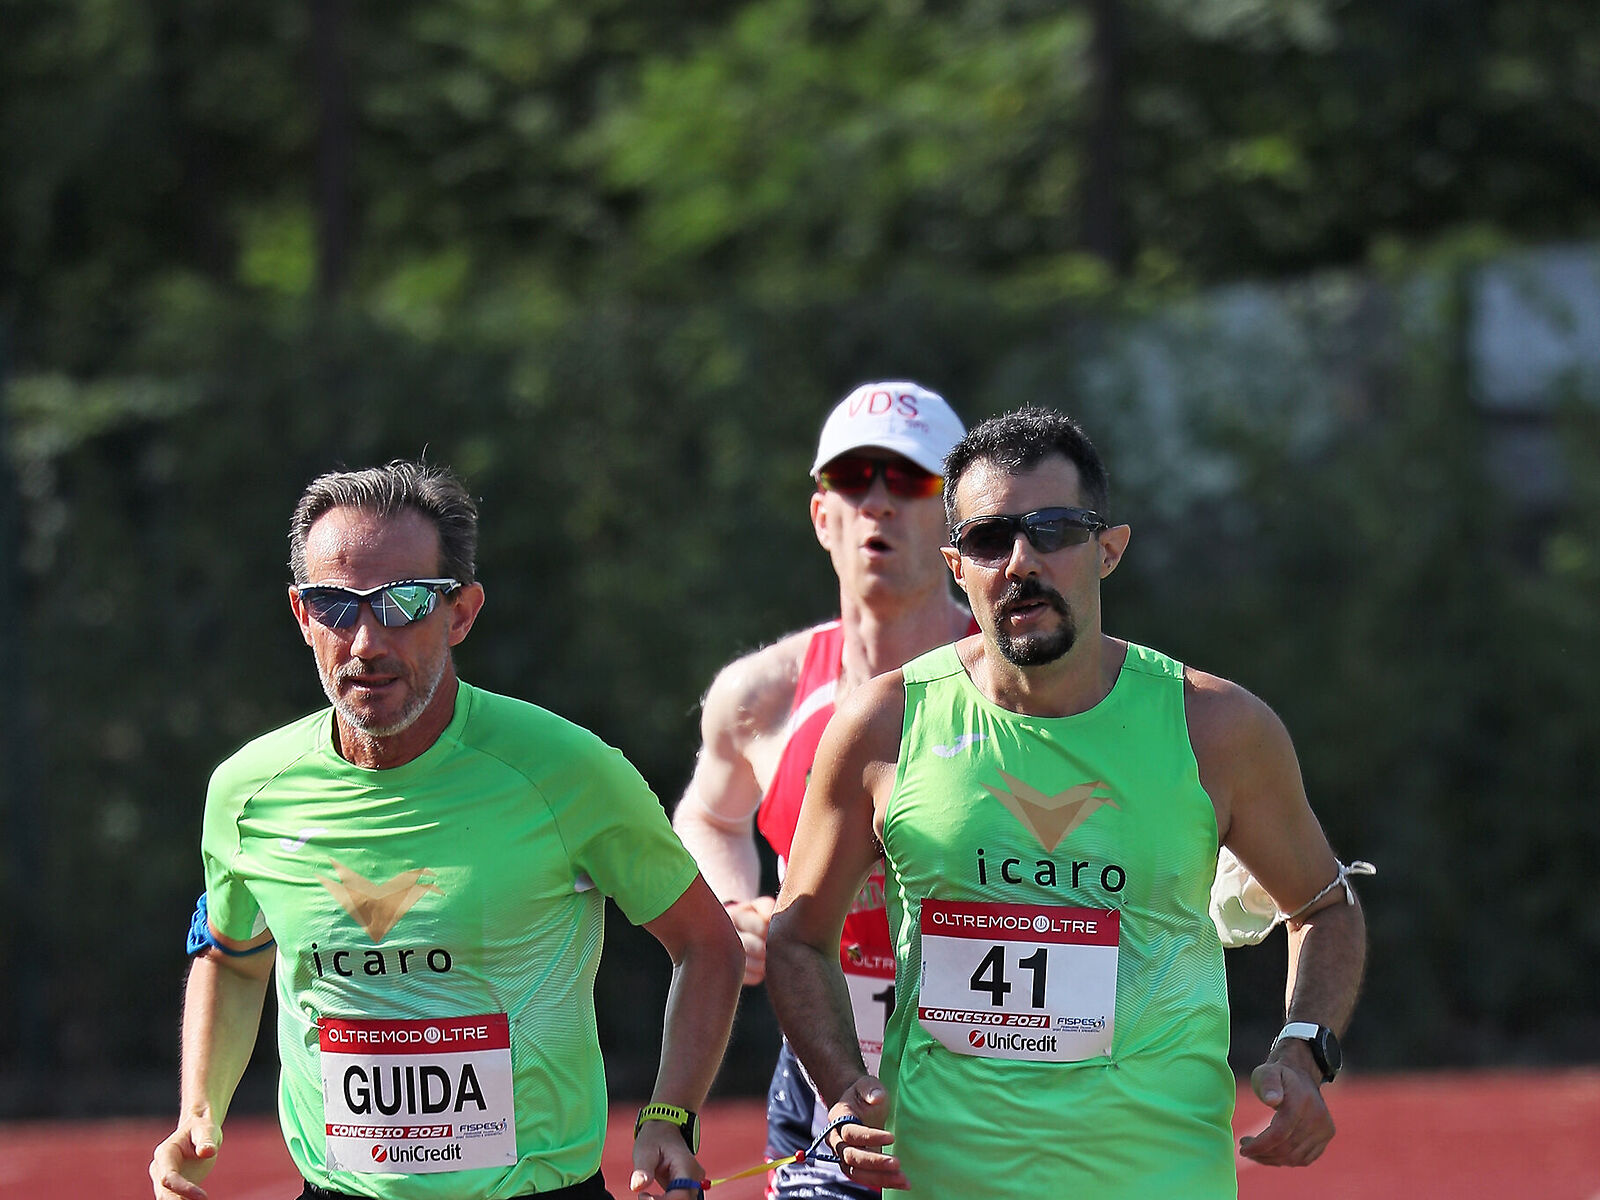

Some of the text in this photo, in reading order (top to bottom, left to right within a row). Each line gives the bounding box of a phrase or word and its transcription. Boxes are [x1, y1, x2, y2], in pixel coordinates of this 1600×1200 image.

[848, 391, 918, 418] VDS
[976, 848, 1127, 893] icaro
[311, 942, 453, 978] icaro
[969, 944, 1049, 1010] 41
[924, 1009, 1047, 1028] CONCESIO 2021
[986, 1033, 1058, 1053] UniCredit
[343, 1063, 488, 1116] GUIDA
[331, 1124, 405, 1139] CONCESIO
[407, 1125, 450, 1138] 2021
[389, 1143, 463, 1163] UniCredit
